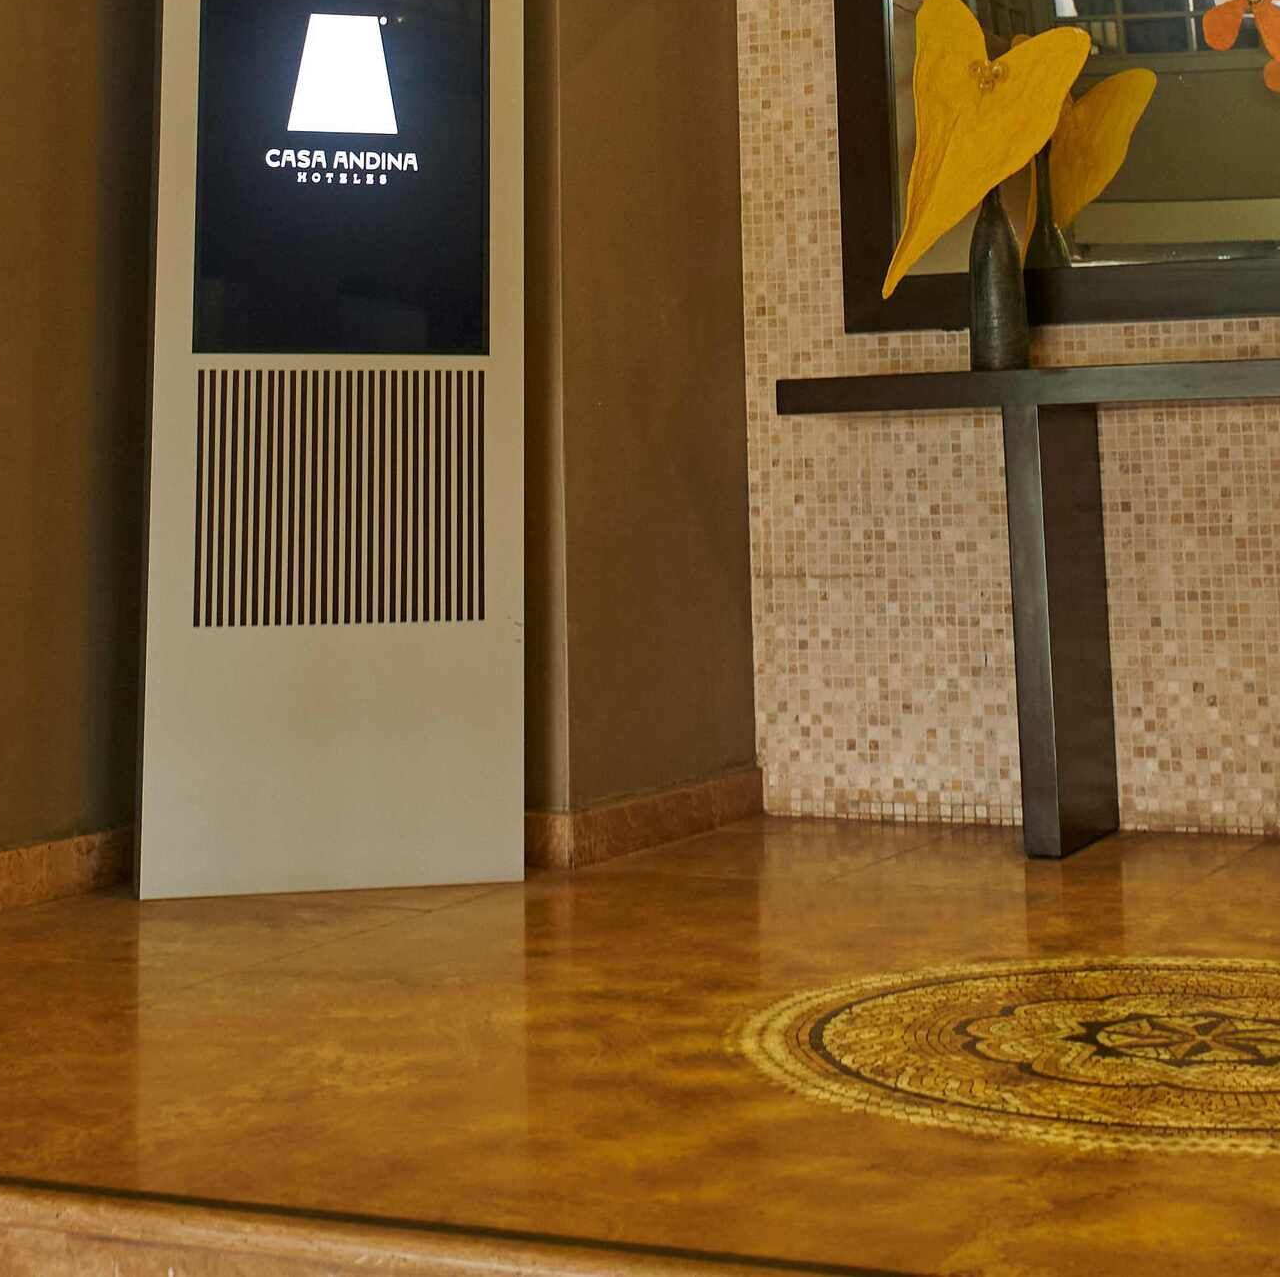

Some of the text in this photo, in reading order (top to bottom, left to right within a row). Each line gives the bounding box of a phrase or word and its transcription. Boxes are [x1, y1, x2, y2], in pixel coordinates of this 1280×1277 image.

[265, 148, 419, 171] CASA ANDINA
[296, 171, 388, 185] HOTELES
